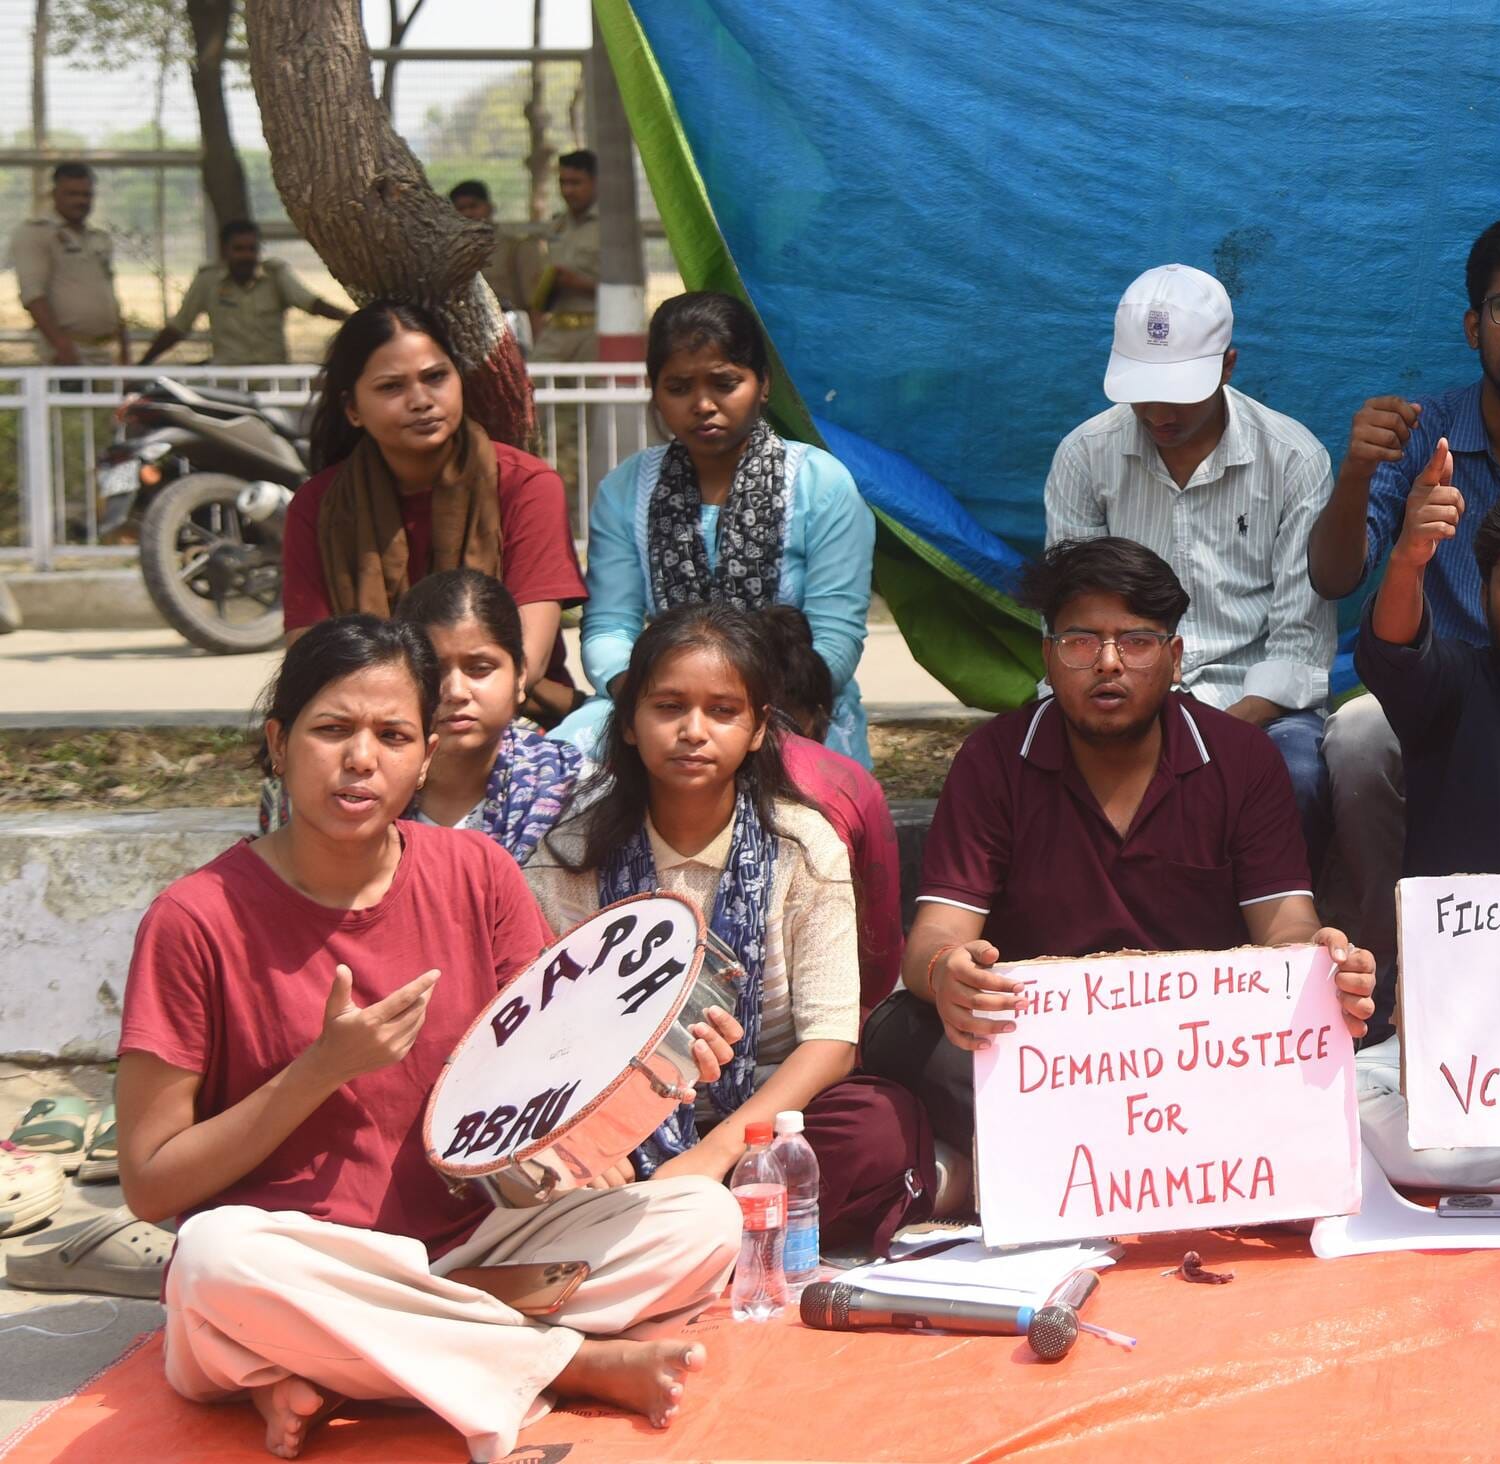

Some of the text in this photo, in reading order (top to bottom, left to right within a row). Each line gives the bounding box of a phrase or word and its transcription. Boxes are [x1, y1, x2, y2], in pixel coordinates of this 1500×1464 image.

[1436, 892, 1500, 938] FILE
[490, 914, 686, 1047] BAPSA
[1084, 970, 1198, 1015] KILLED
[1019, 1020, 1331, 1093] DEMAND JUSTICE
[442, 1079, 582, 1160] BBAU
[1126, 1092, 1188, 1136] FOR
[1059, 1144, 1276, 1217] ANAMIKA
